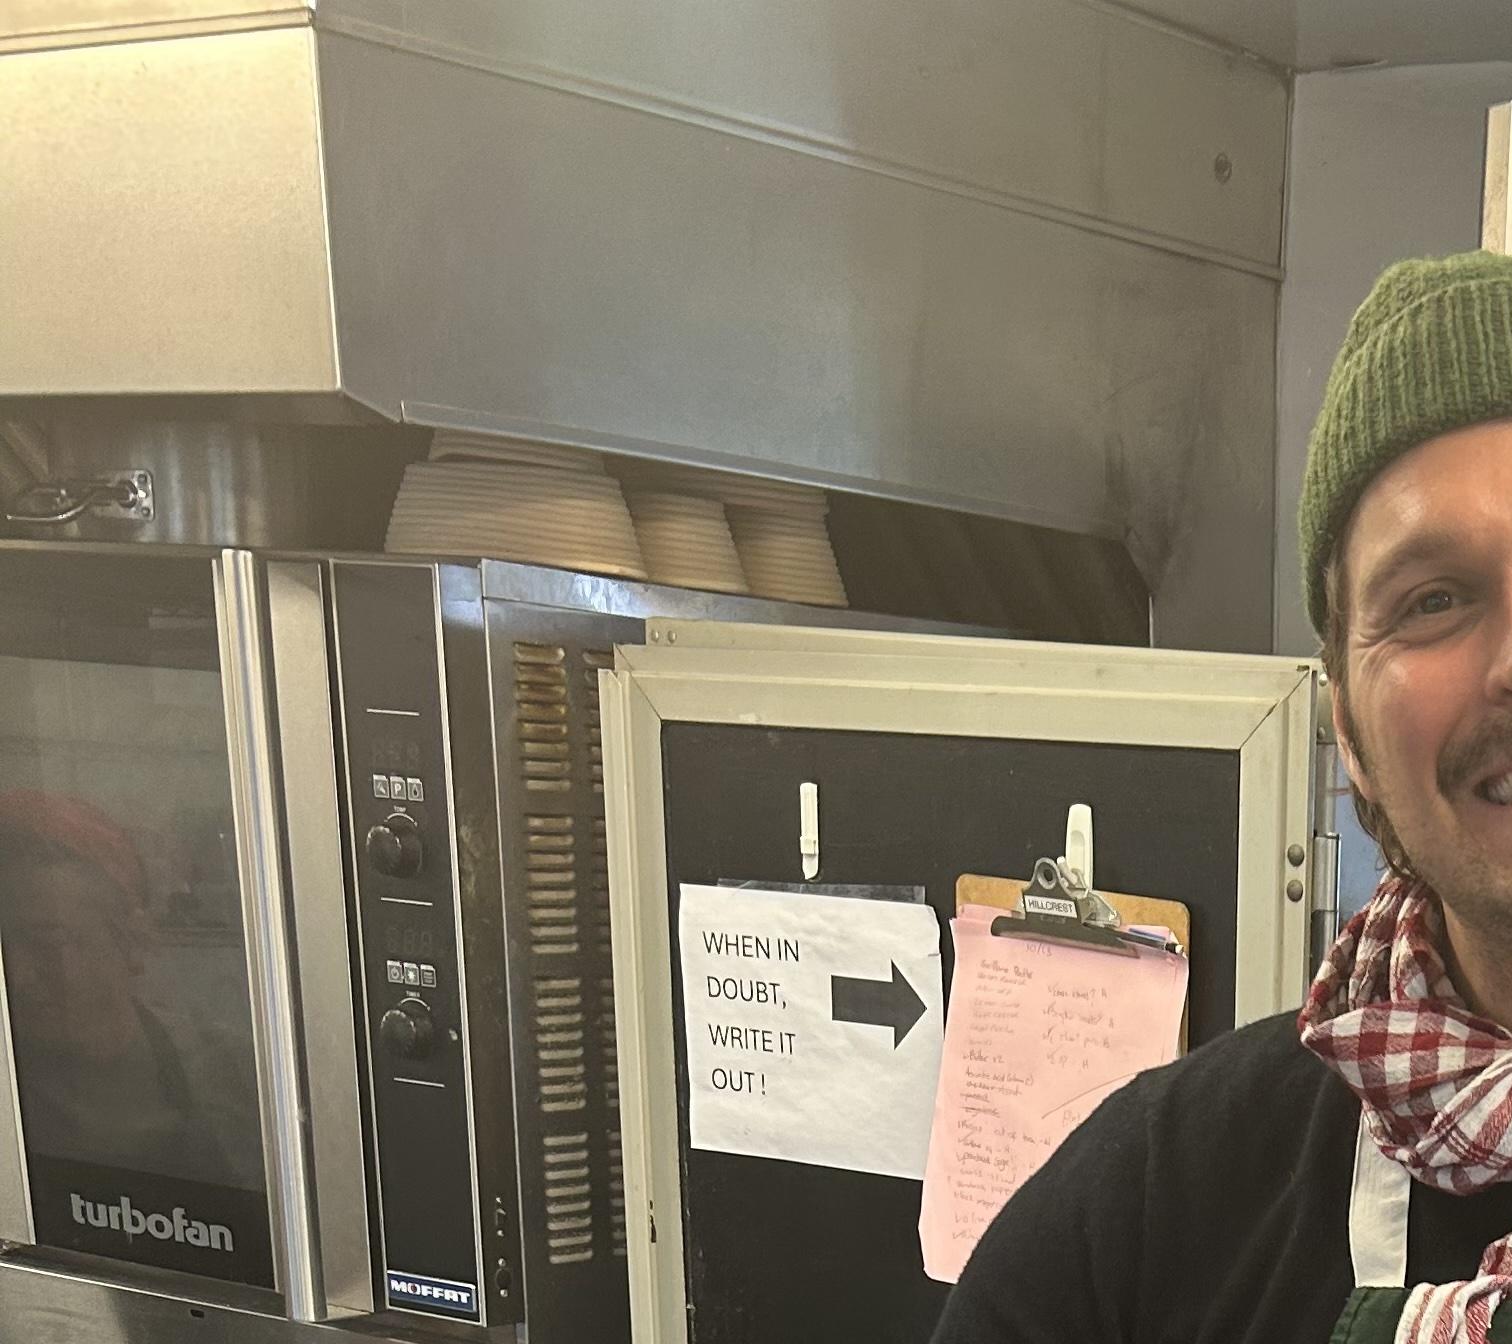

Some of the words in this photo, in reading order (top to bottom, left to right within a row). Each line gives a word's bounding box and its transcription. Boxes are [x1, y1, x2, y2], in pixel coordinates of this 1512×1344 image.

[1028, 899, 1074, 914] HILLCREST
[702, 930, 771, 959] WHEN
[777, 938, 800, 962] IN
[706, 975, 787, 1010] DOUBT,
[707, 1023, 774, 1053] WRITE
[779, 1031, 796, 1055] IT
[711, 1067, 755, 1093] OUT
[70, 1193, 234, 1252] turbofan
[390, 1279, 471, 1304] MOFFAT
